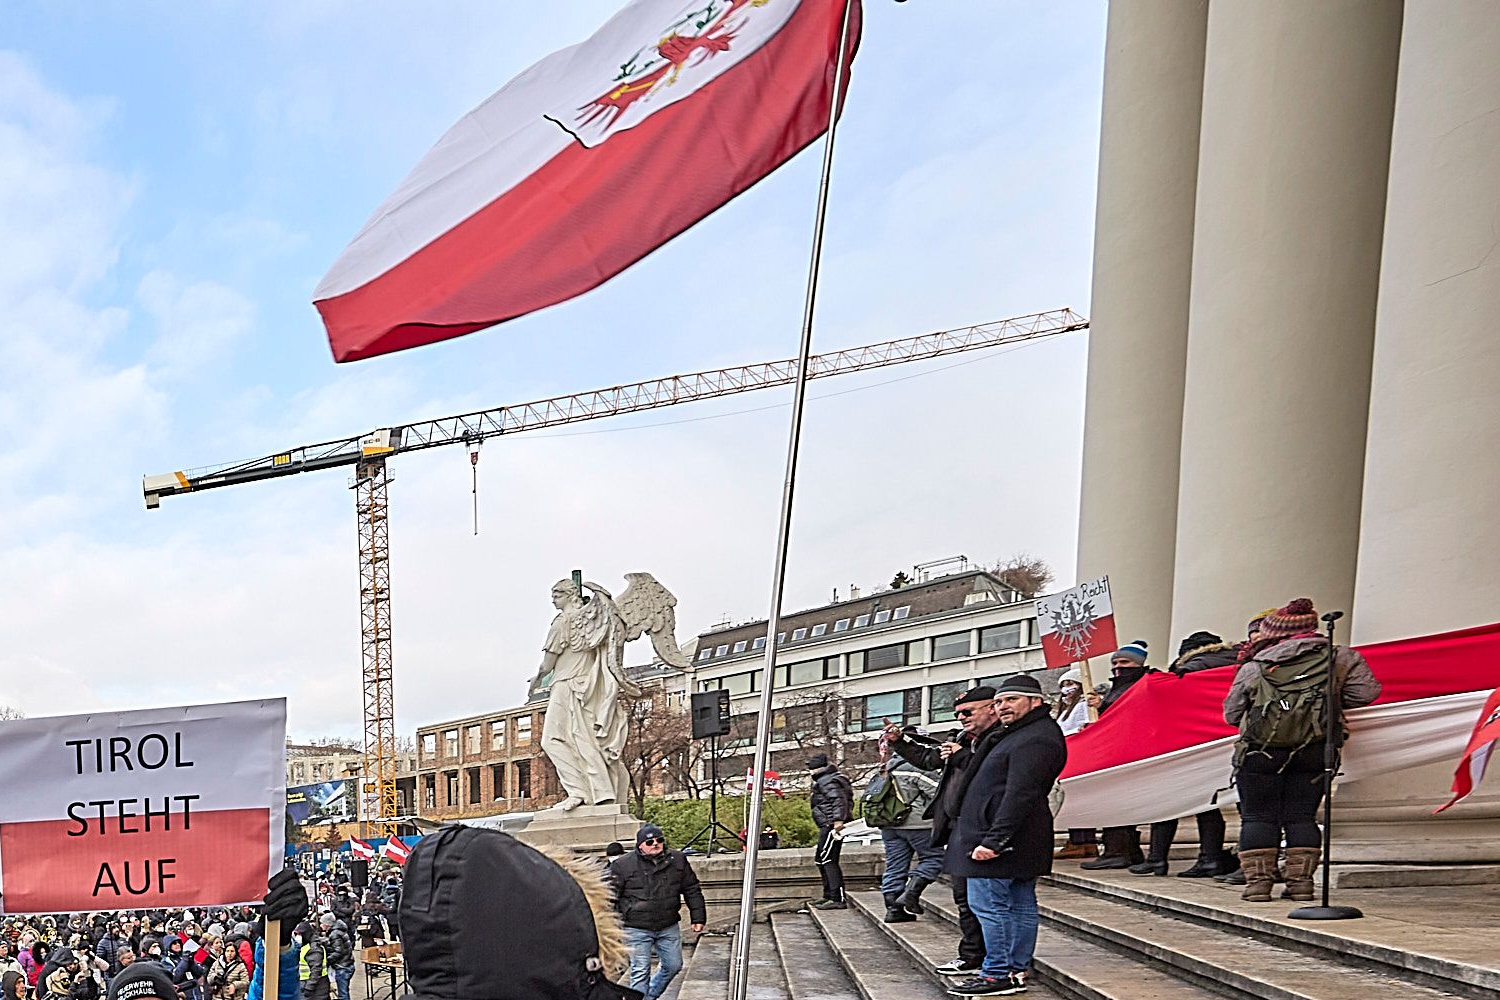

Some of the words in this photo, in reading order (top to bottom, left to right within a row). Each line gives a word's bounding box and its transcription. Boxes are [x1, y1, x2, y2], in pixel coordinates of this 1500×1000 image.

[1036, 601, 1049, 617] Es
[66, 732, 194, 775] TIROL
[67, 794, 200, 837] STEHT
[92, 858, 176, 897] AUF
[117, 980, 154, 996] FEUERWEHR
